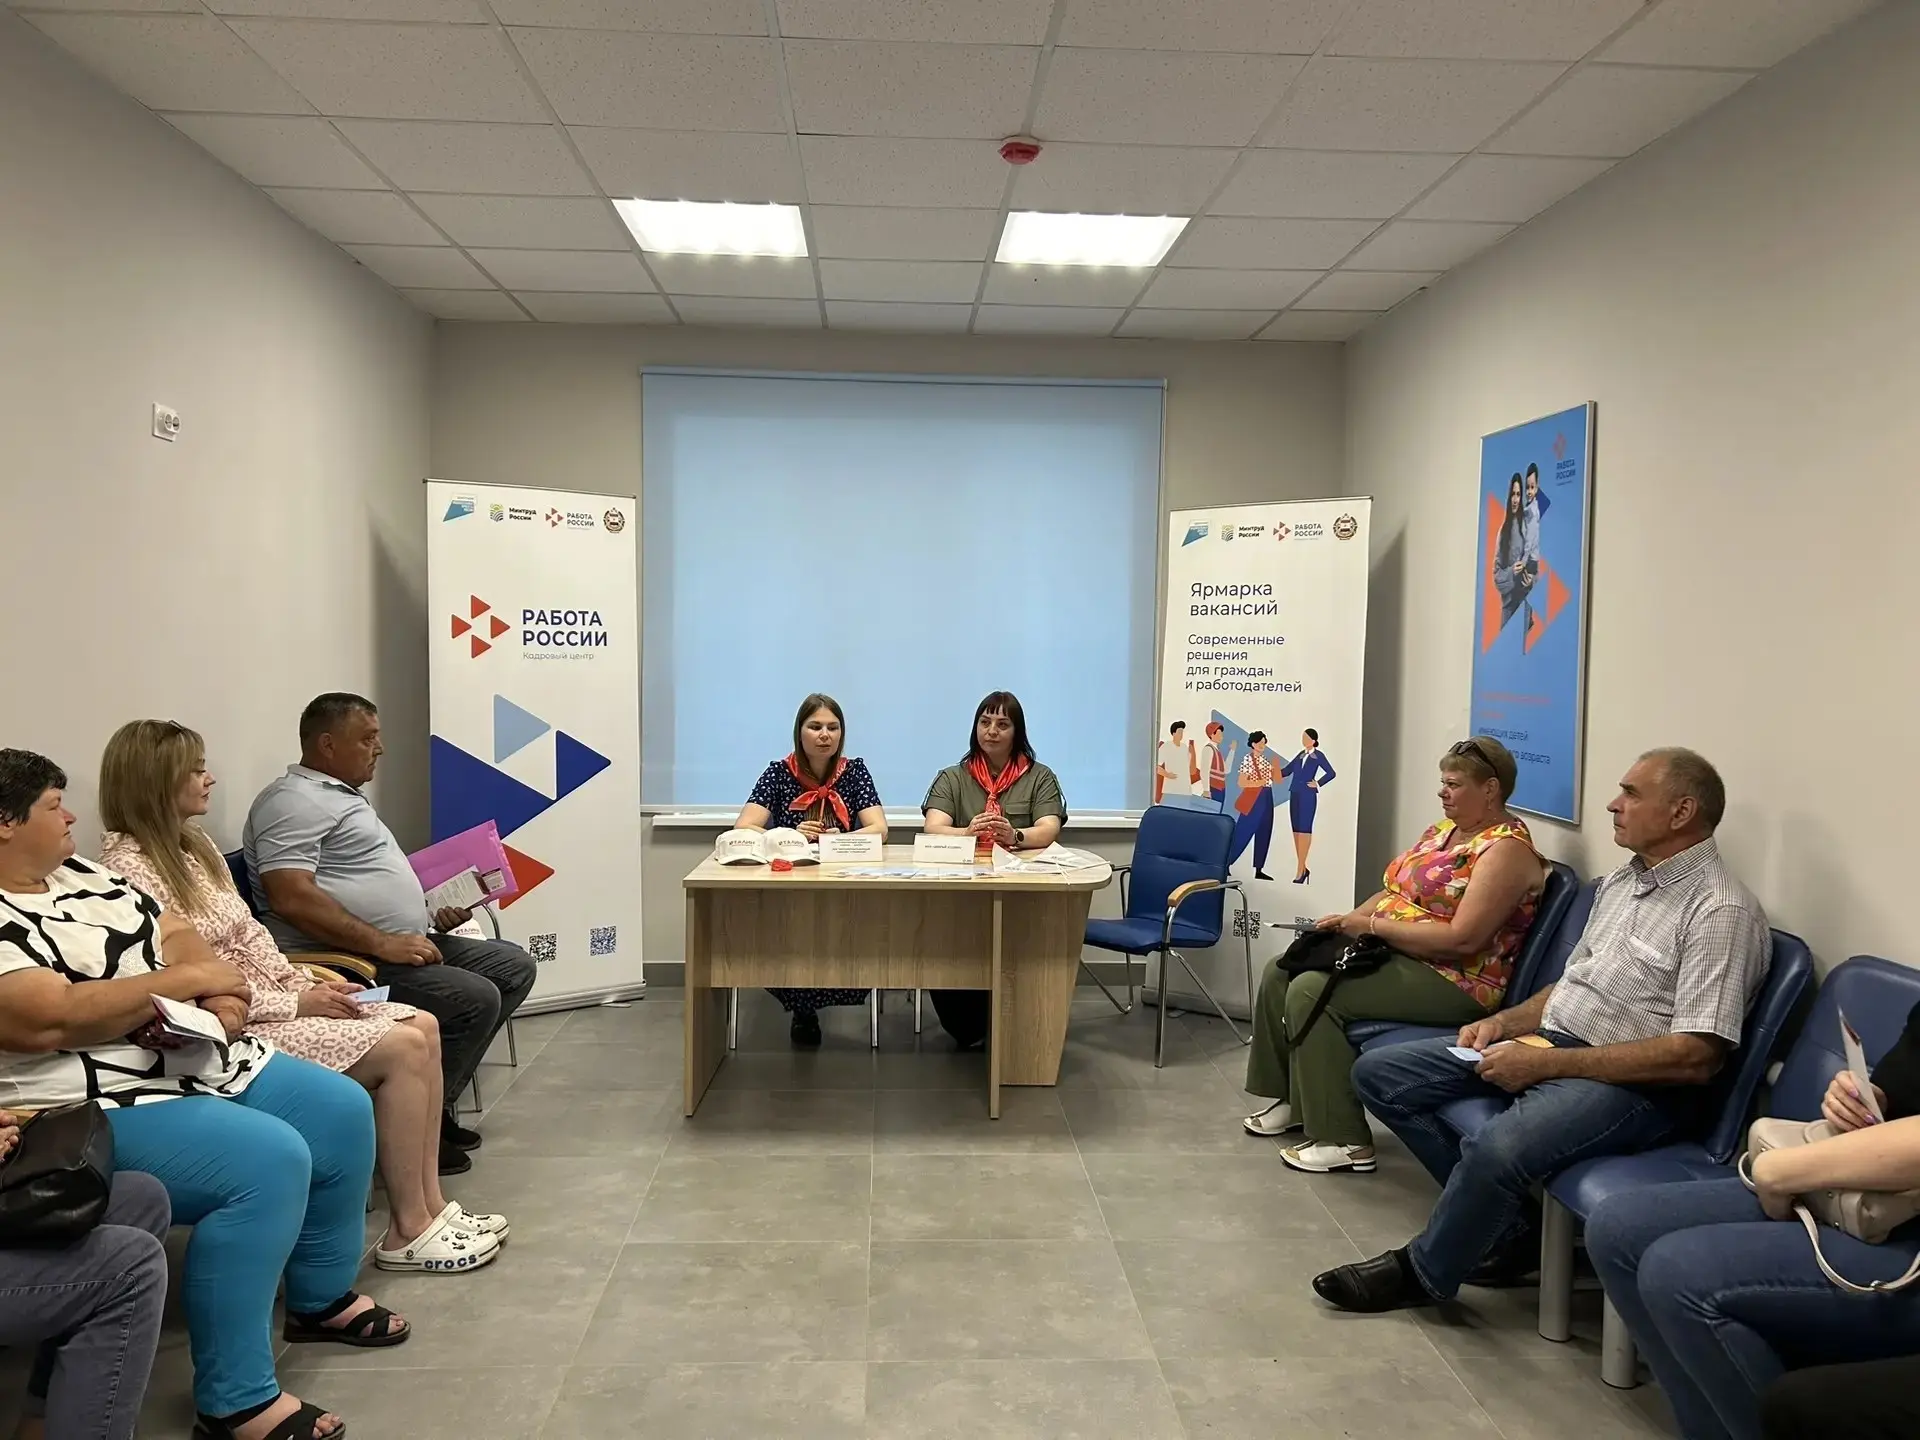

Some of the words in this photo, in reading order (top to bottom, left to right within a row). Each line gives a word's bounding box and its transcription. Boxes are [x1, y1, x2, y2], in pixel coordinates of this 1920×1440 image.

[509, 507, 537, 515] Минтруд
[1190, 582, 1273, 600] Ярмарка
[1190, 600, 1278, 616] вакансий
[523, 609, 602, 626] РАБОТА
[523, 630, 607, 646] РОССИИ
[1188, 634, 1285, 647] Современные
[523, 652, 567, 660] Кадровый
[1187, 651, 1248, 662] решения
[1186, 666, 1210, 676] для
[1214, 666, 1273, 677] граждан
[1185, 680, 1193, 689] и
[1196, 679, 1302, 693] работодателей
[424, 1254, 477, 1269] crocs
